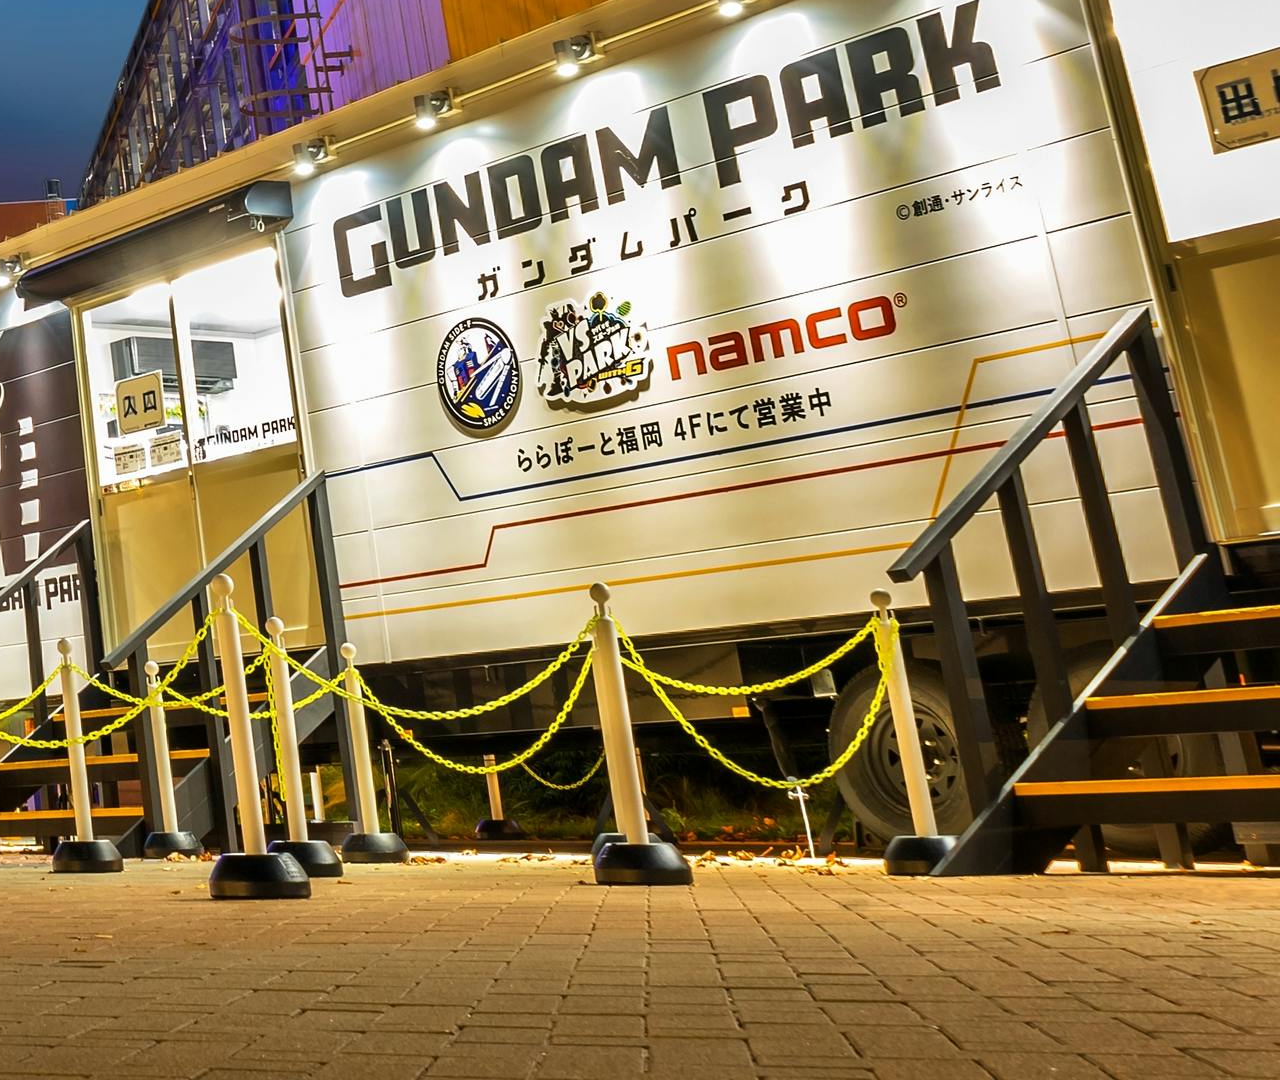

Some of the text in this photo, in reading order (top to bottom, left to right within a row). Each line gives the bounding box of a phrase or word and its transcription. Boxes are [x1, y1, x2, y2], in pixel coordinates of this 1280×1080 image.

[1217, 69, 1280, 124] 出
[333, 0, 1001, 298] GUNDAM PARK
[477, 181, 810, 301] ガンダムパーク
[439, 341, 450, 384] GUNDAM
[557, 319, 590, 361] VS
[566, 328, 631, 388] PARK
[123, 390, 157, 418] 入口
[483, 370, 518, 426] SPACE COLONY
[262, 416, 296, 439] PARK
[517, 387, 832, 473] ららぽーと福岡 4Fにて営業中
